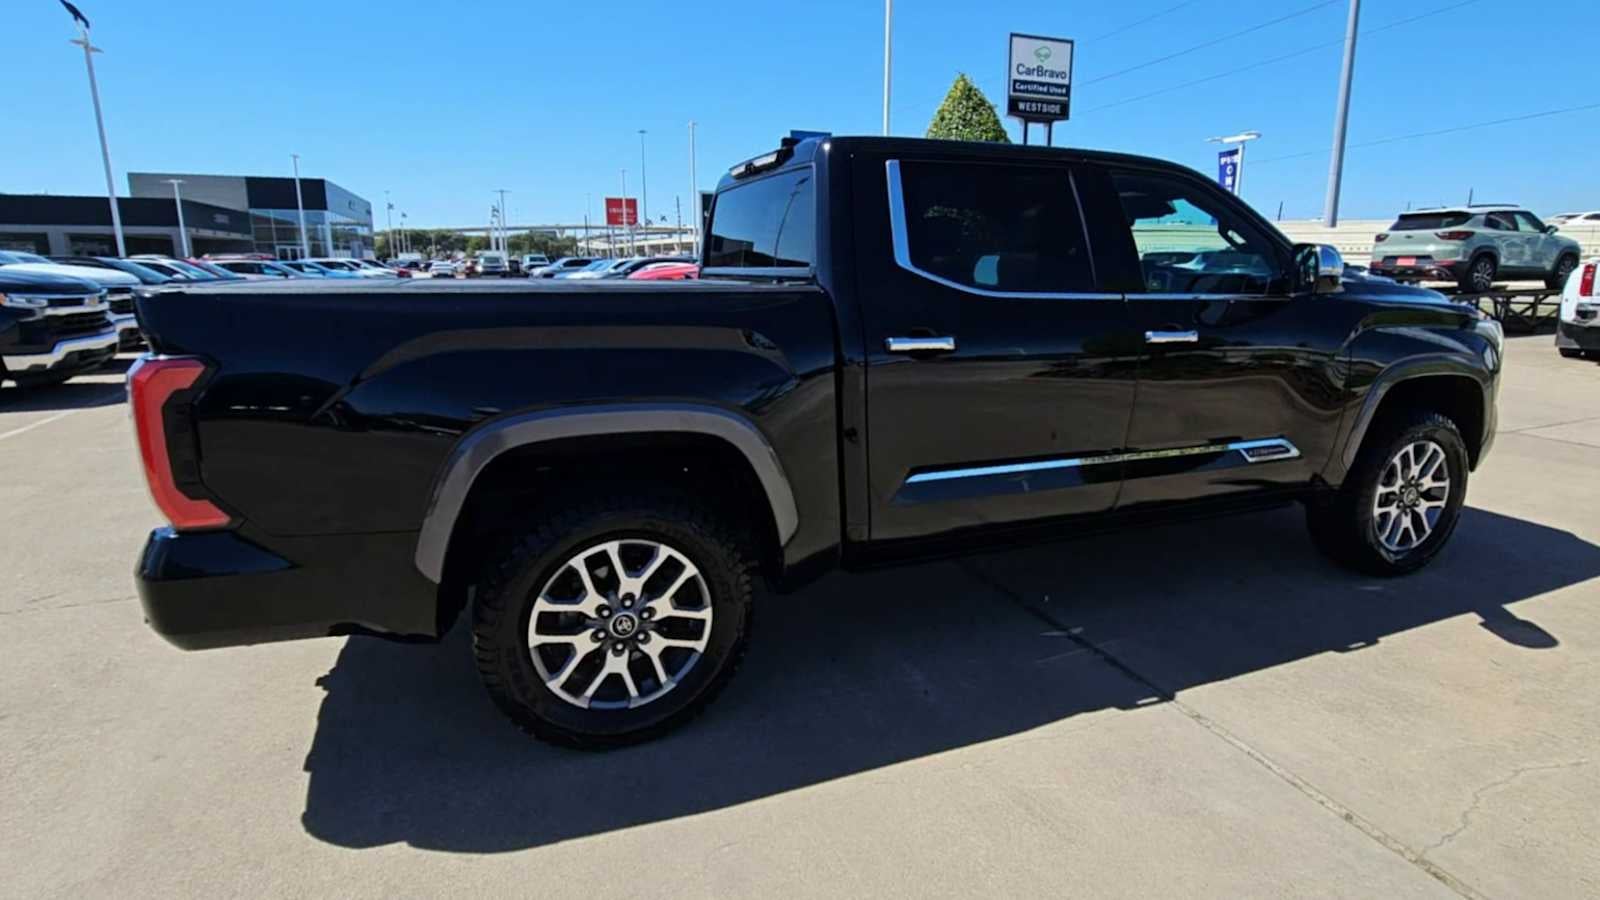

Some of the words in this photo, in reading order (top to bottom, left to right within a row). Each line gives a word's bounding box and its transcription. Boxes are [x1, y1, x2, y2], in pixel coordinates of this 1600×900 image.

[1016, 63, 1067, 79] CarBravo
[1015, 82, 1048, 92] Certified
[1049, 86, 1066, 94] Used
[1018, 101, 1061, 114] WESTSIDE
